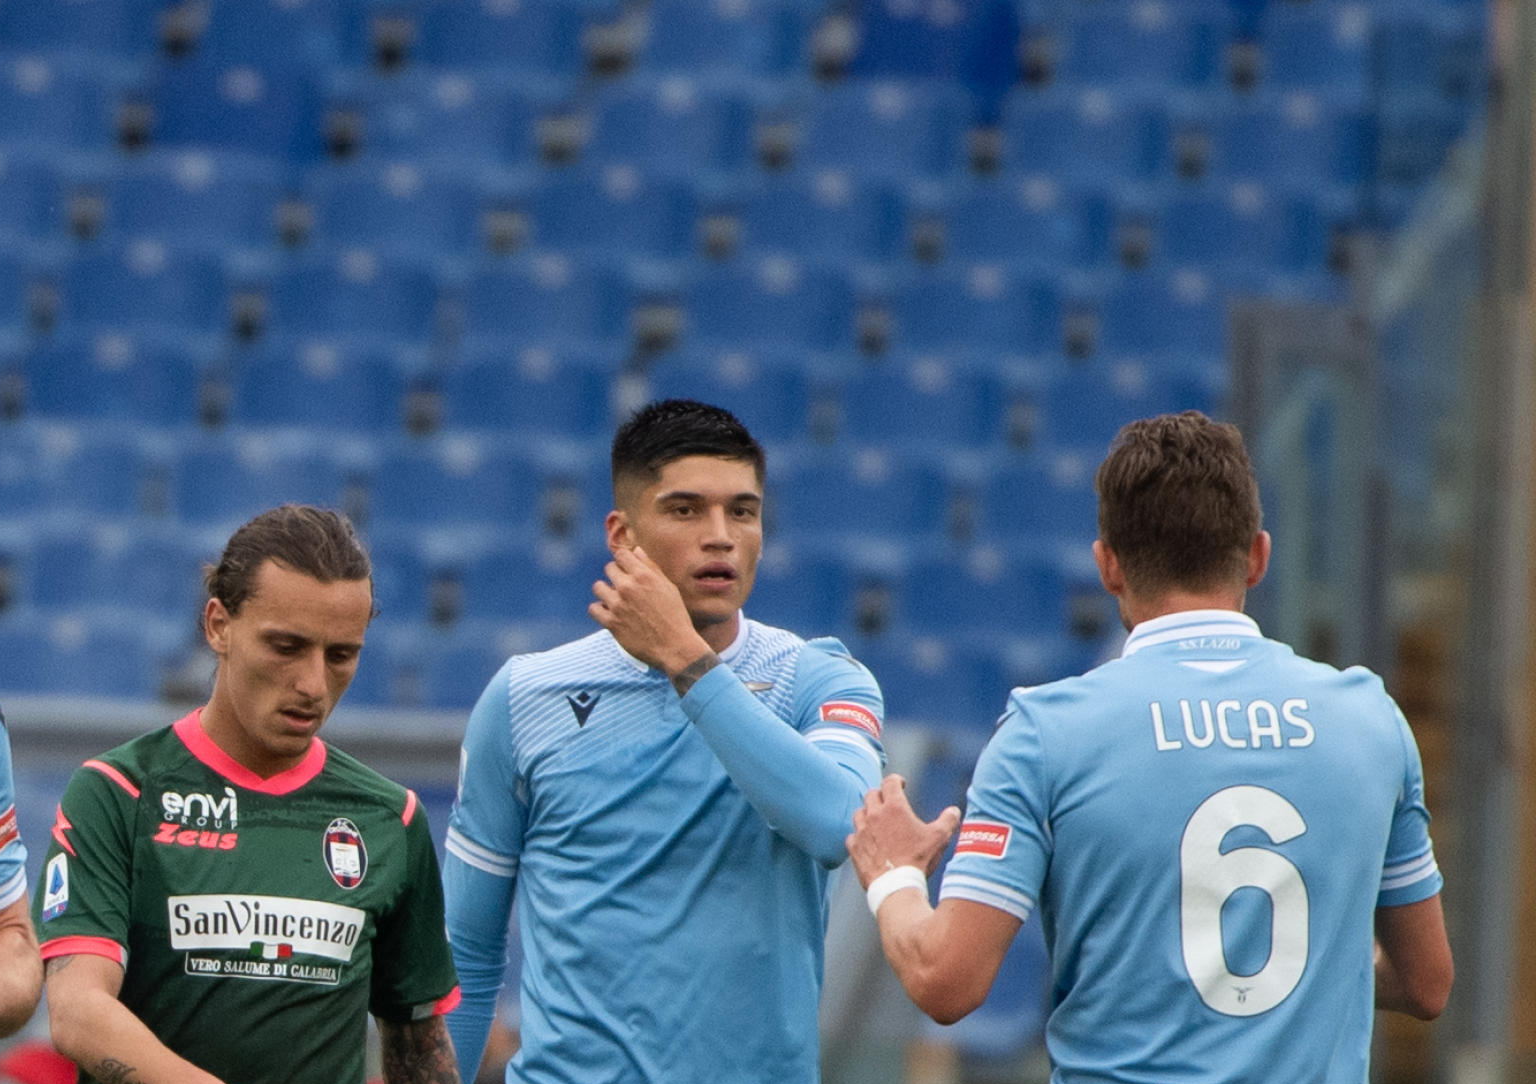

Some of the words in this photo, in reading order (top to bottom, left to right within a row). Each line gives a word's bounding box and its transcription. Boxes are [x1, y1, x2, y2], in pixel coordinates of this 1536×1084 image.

[1149, 698, 1315, 751] LUCAS
[164, 811, 238, 830] GROUP
[153, 822, 238, 850] Zeus
[1178, 784, 1309, 1018] 6
[190, 958, 221, 973] VERO
[224, 960, 270, 976] SALUME
[274, 963, 287, 976] DI
[290, 965, 337, 981] CALABRIA
